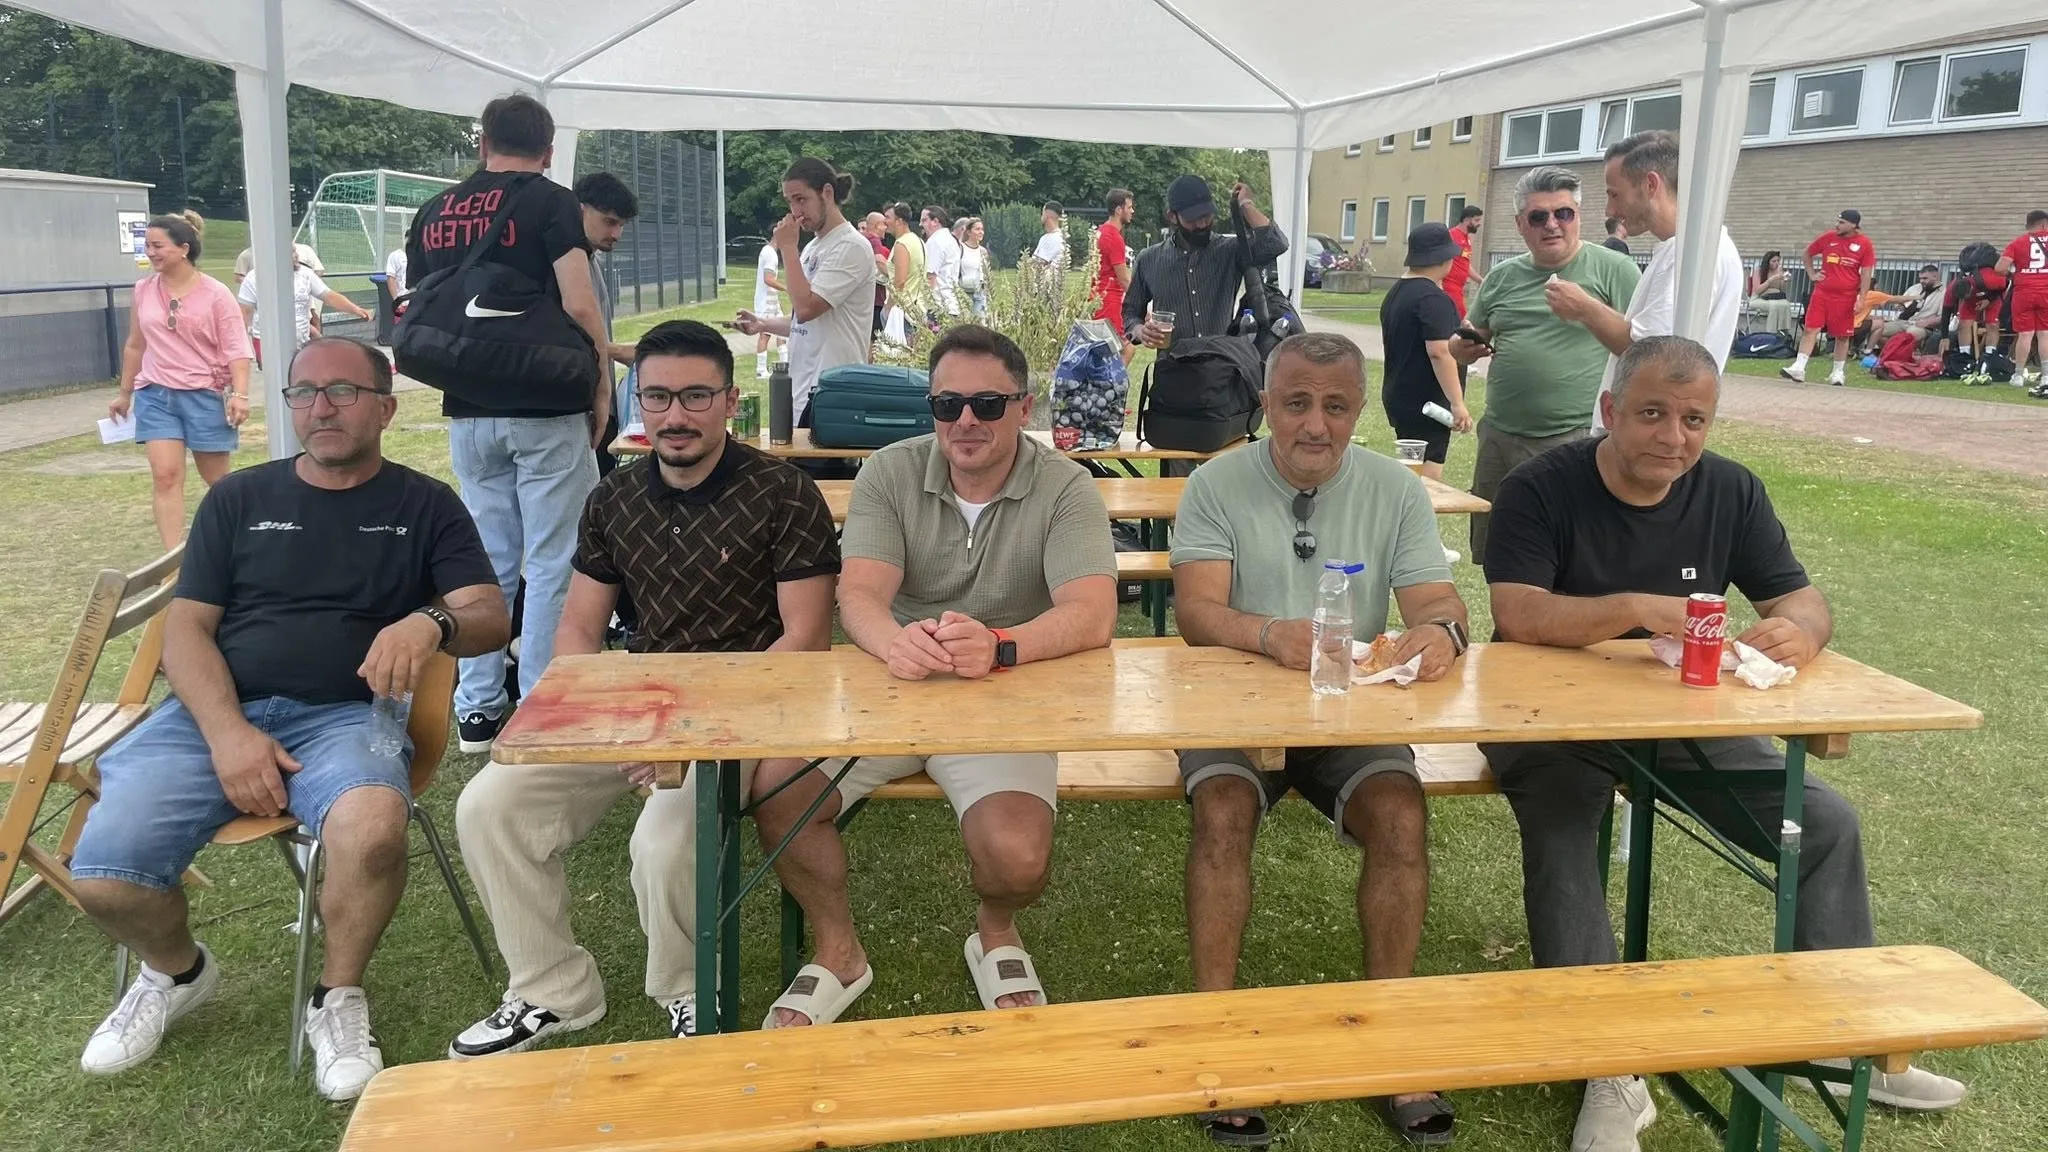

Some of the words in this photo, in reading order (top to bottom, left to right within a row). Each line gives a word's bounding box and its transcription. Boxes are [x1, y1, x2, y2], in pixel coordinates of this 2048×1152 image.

[440, 189, 504, 216] DEPT.
[2030, 243, 2046, 269] 9
[256, 520, 297, 531] DHL
[71, 634, 96, 674] HAMM
